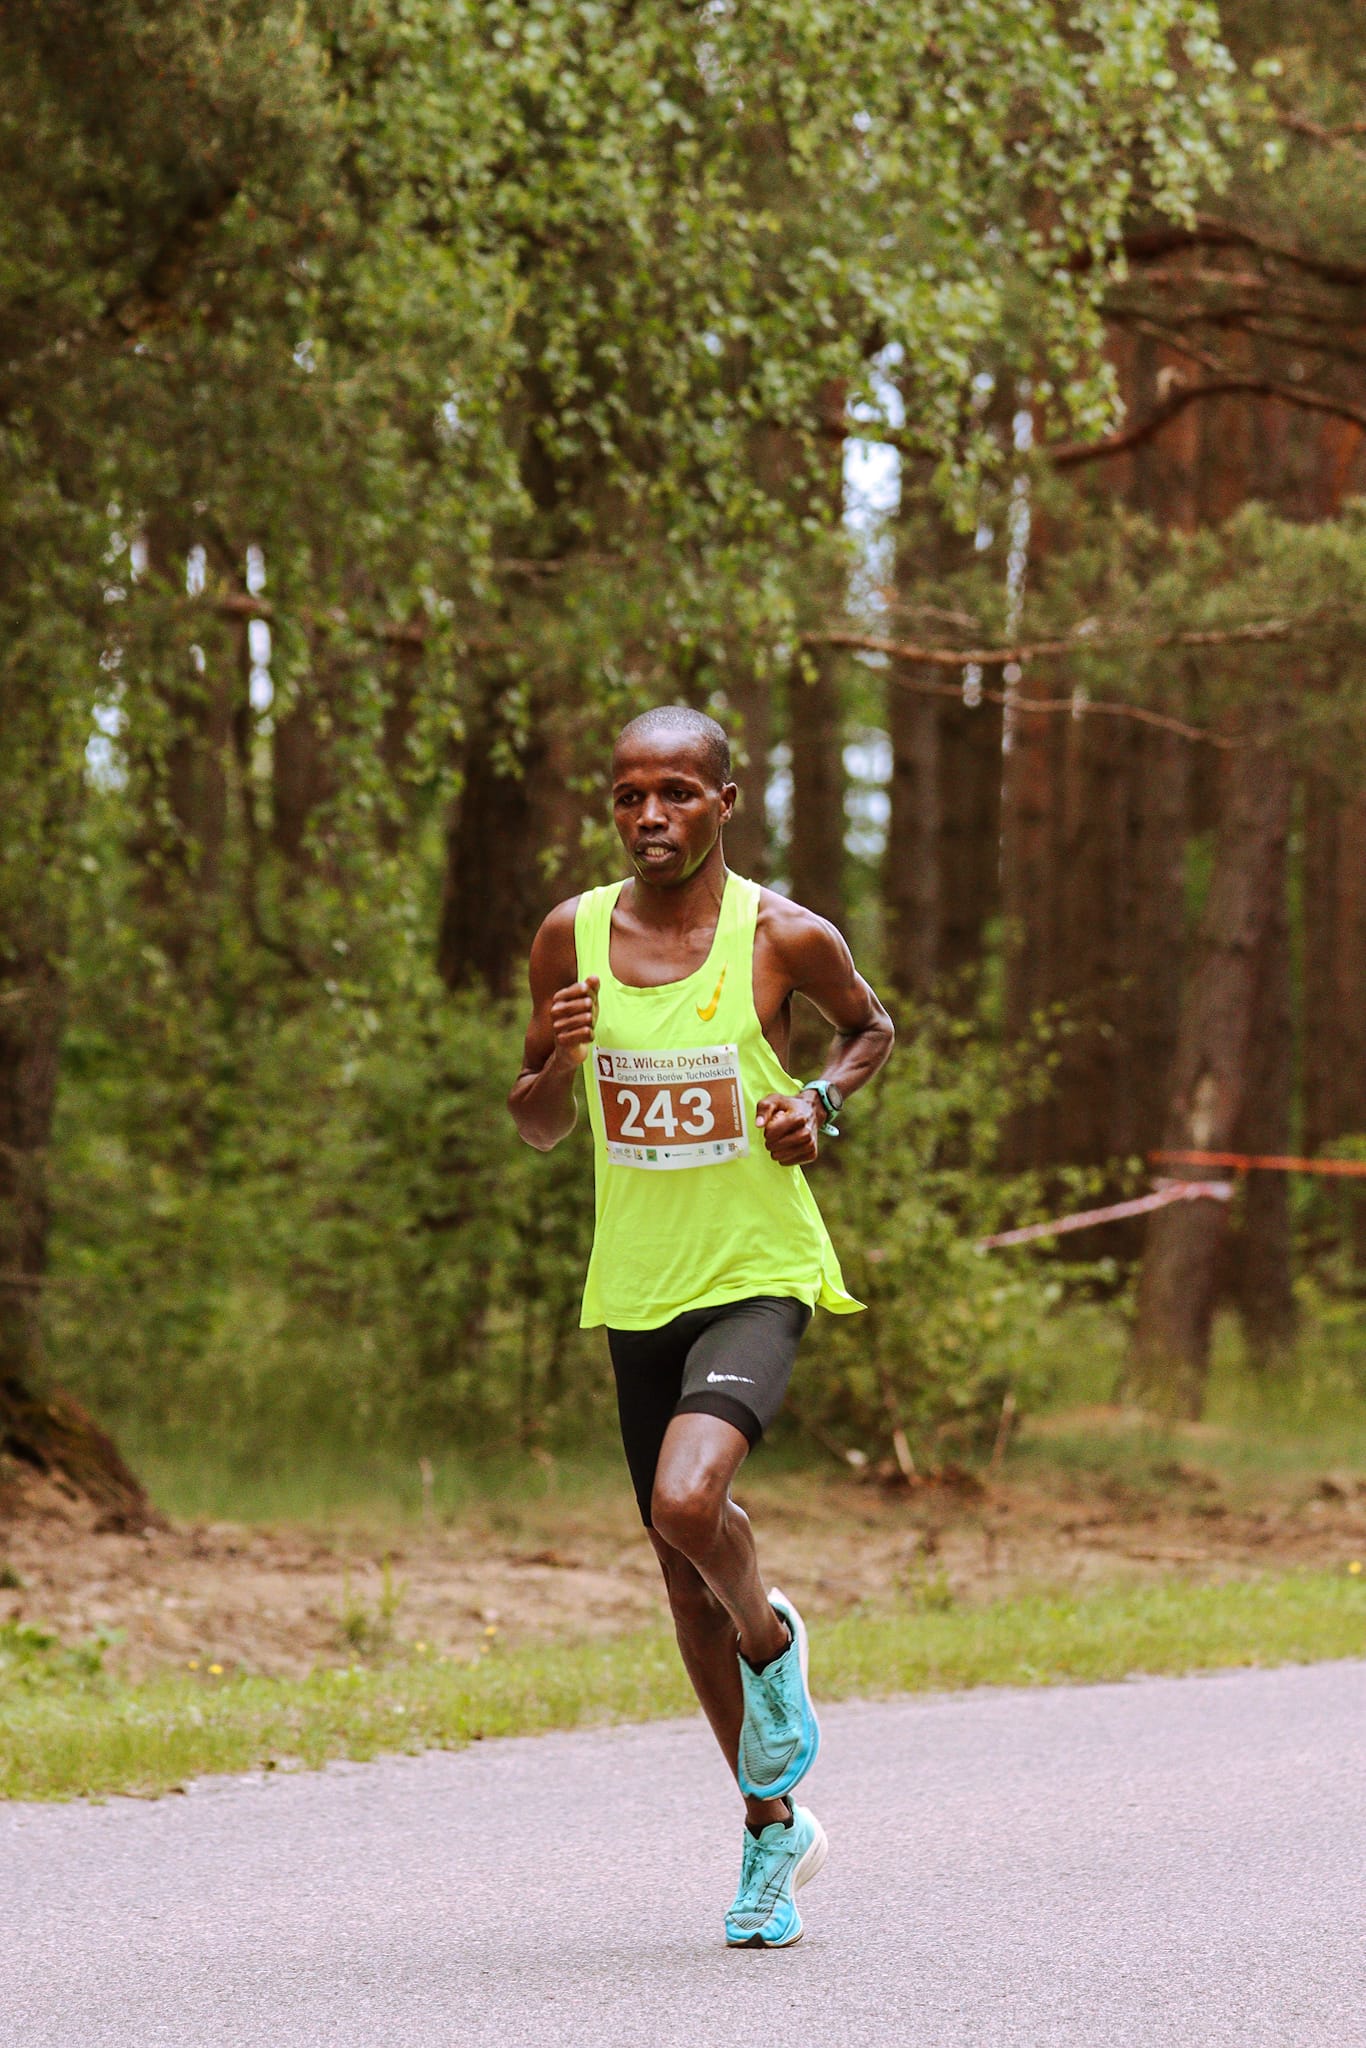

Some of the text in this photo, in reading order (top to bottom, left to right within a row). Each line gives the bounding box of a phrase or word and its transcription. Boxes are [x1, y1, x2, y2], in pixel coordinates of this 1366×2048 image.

[616, 1054, 719, 1069] 22. Wilcza Dycha
[617, 1066, 735, 1083] Grand Prix Borów Tucholskich
[616, 1087, 715, 1138] 243
